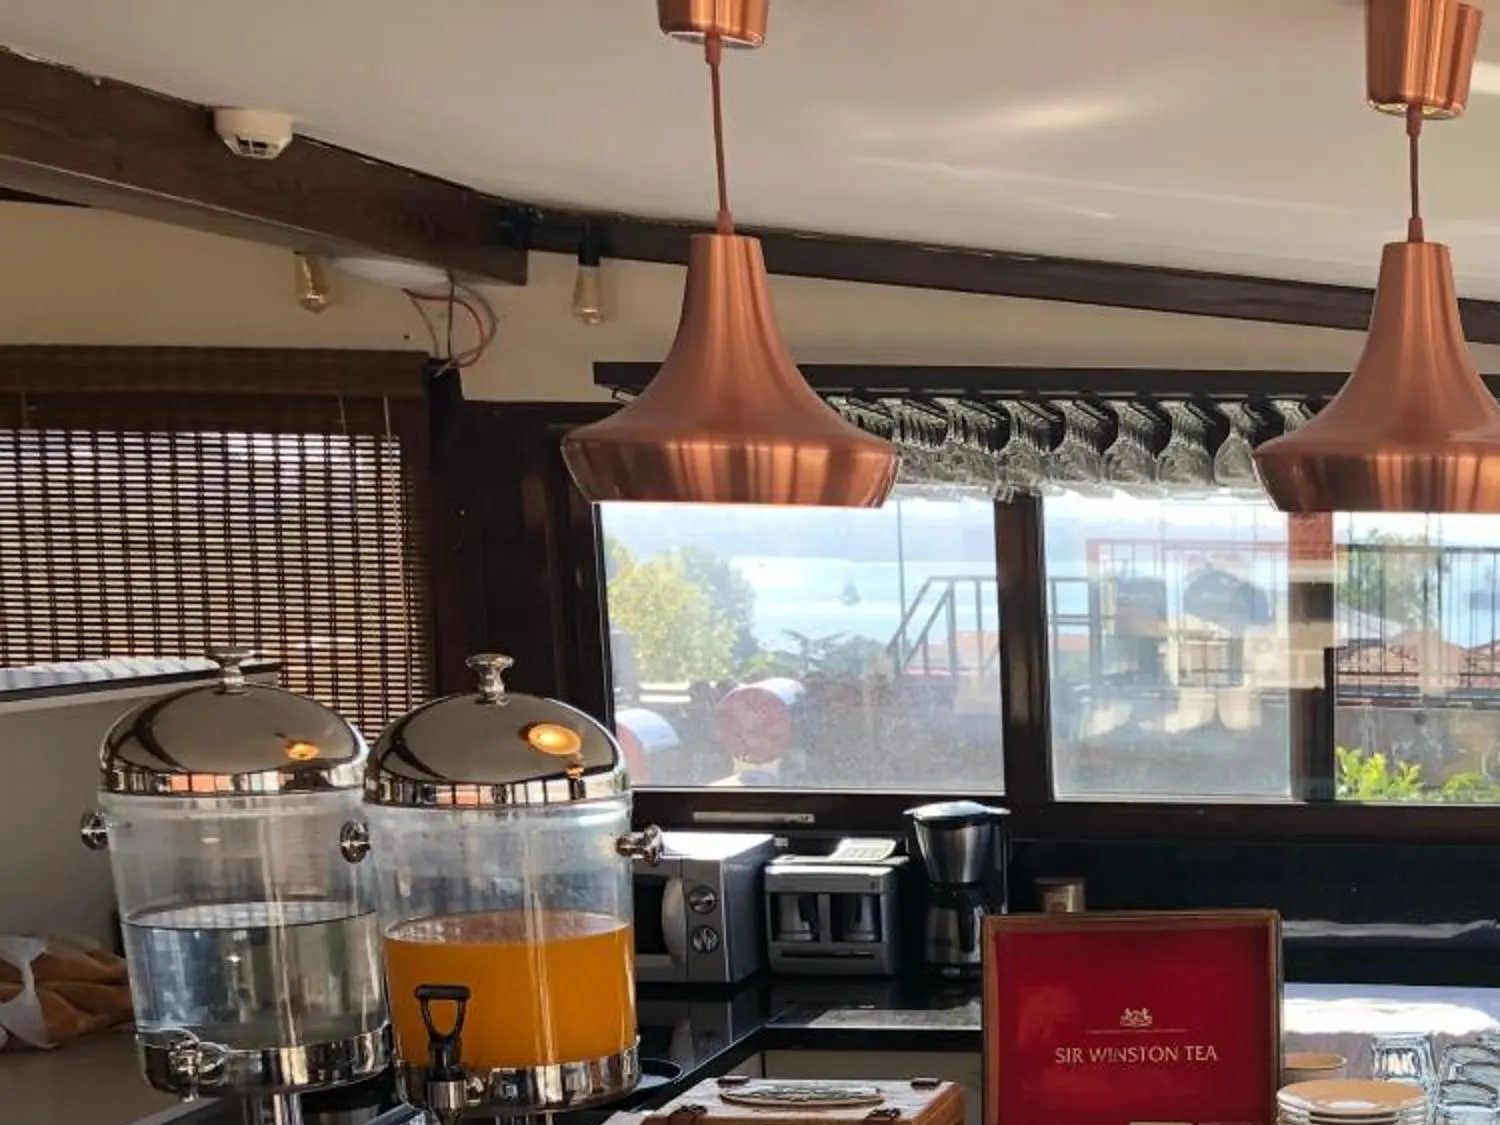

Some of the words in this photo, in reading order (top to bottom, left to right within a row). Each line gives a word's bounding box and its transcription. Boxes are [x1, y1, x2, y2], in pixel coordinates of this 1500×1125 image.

[1055, 1047, 1084, 1063] SIR
[1088, 1045, 1179, 1063] WINSTON
[1184, 1045, 1218, 1061] TEA
